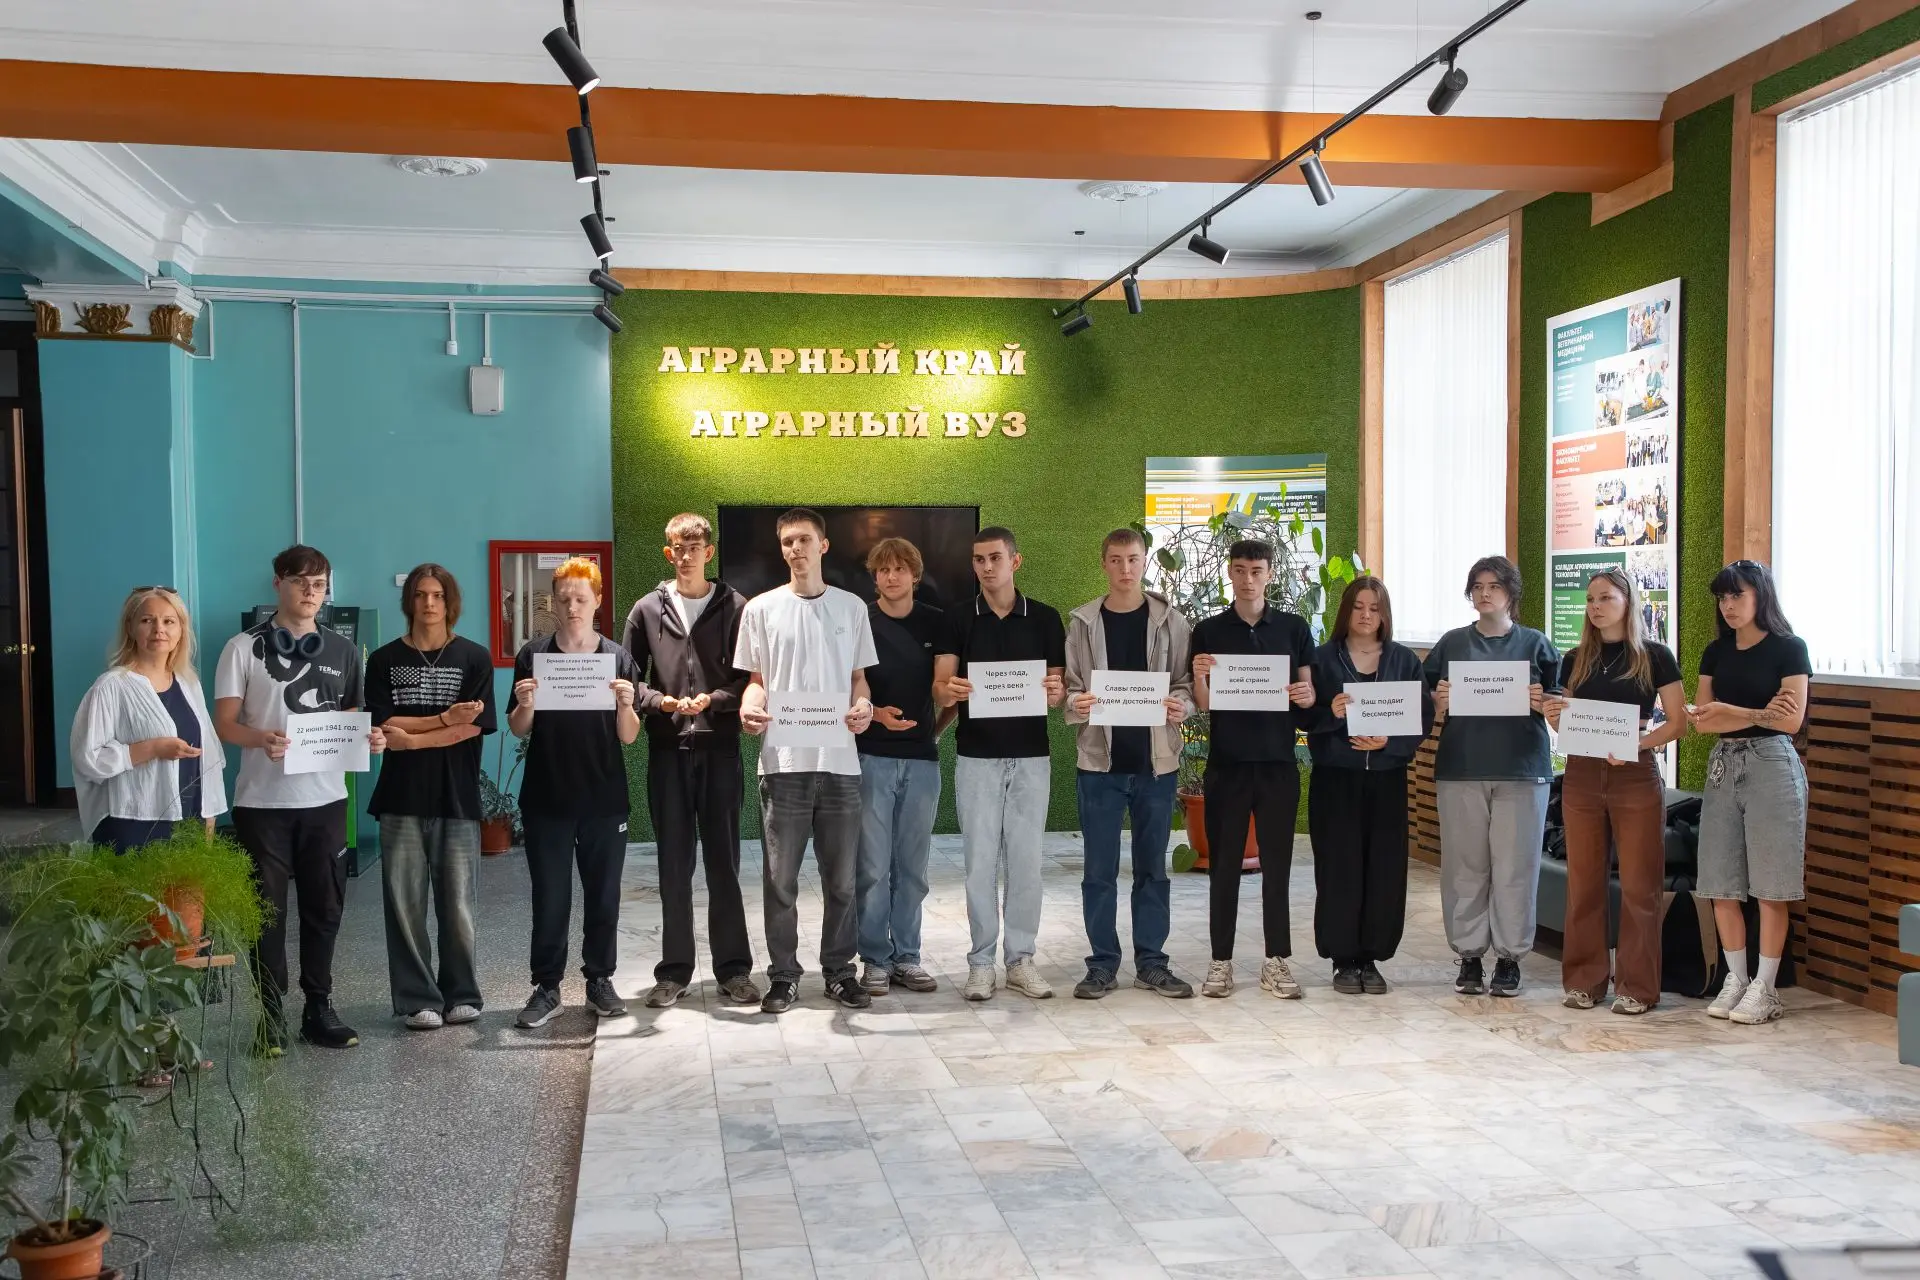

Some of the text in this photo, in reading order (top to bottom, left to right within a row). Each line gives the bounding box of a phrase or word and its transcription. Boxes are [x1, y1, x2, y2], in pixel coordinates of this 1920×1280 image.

[658, 342, 1027, 375] АГРАРНЫЙ КРАЙ
[690, 404, 1027, 437] АГРАРНЫЙ ВУЗ
[318, 665, 342, 677] TERMIT
[985, 670, 1008, 678] Через
[1473, 687, 1504, 695] героям!
[990, 694, 1025, 703] помните!
[1097, 696, 1120, 705] будем
[1377, 698, 1404, 706] подвиг
[1361, 710, 1404, 718] бессмертен
[778, 718, 793, 726] Мы
[798, 718, 838, 727] гордимся!
[1571, 712, 1594, 721] Никто
[1605, 716, 1628, 726] забыт,
[343, 724, 360, 732] год:
[1567, 726, 1590, 734] ничто
[1602, 728, 1630, 738] забыто!
[300, 739, 318, 747] День
[312, 747, 339, 756] скорби
